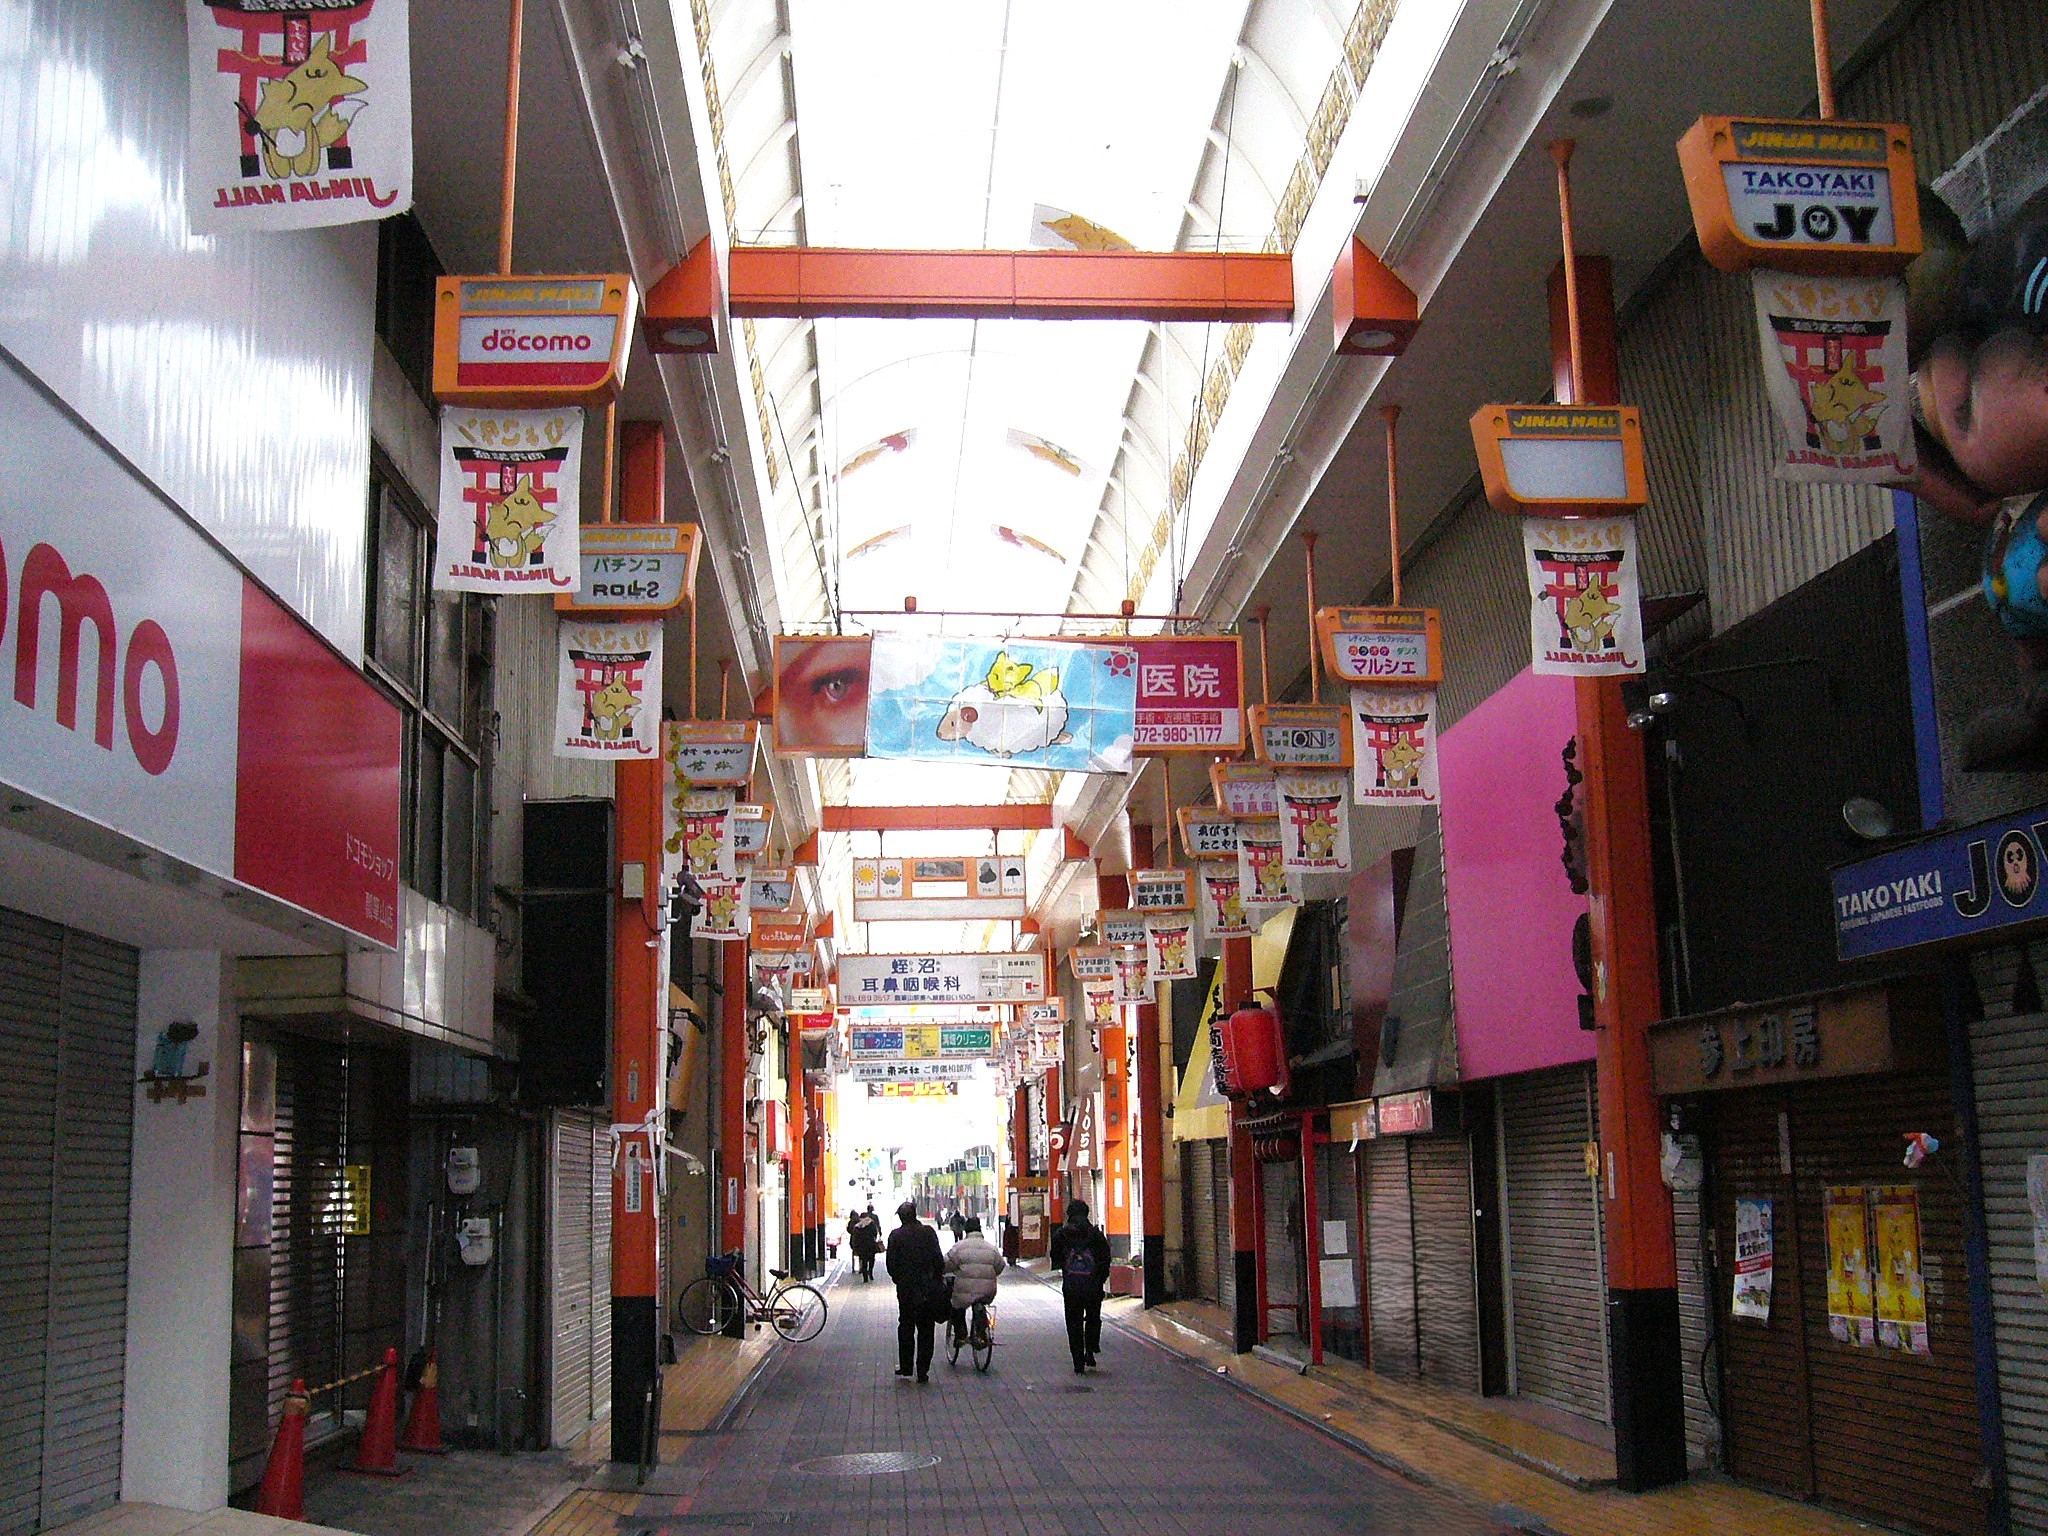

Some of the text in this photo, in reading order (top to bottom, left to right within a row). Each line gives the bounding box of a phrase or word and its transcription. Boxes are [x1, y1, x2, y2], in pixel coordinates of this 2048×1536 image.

[1742, 131, 1879, 150] JINJA MALL
[1742, 171, 1875, 191] TAKOYAKI
[1754, 202, 1880, 243] JOY
[481, 329, 592, 351] docomo
[1513, 415, 1618, 428] JINJA MALL
[594, 558, 661, 573] パチンコ
[0, 542, 181, 776] mo
[1141, 664, 1220, 698] 医院
[1134, 727, 1222, 742] 072-980-1177
[1291, 729, 1327, 748] ON
[346, 832, 394, 881] ドコモショップ
[1137, 893, 1186, 907] 阪本青果
[1838, 870, 1943, 917] TAKOYAKI
[1106, 931, 1146, 942] キムチナラ
[891, 957, 936, 975] 蛭沼
[1077, 958, 1111, 966] みずほ銀行
[862, 976, 961, 993] 耳鼻咽喉科
[883, 1082, 946, 1096] ロールス
